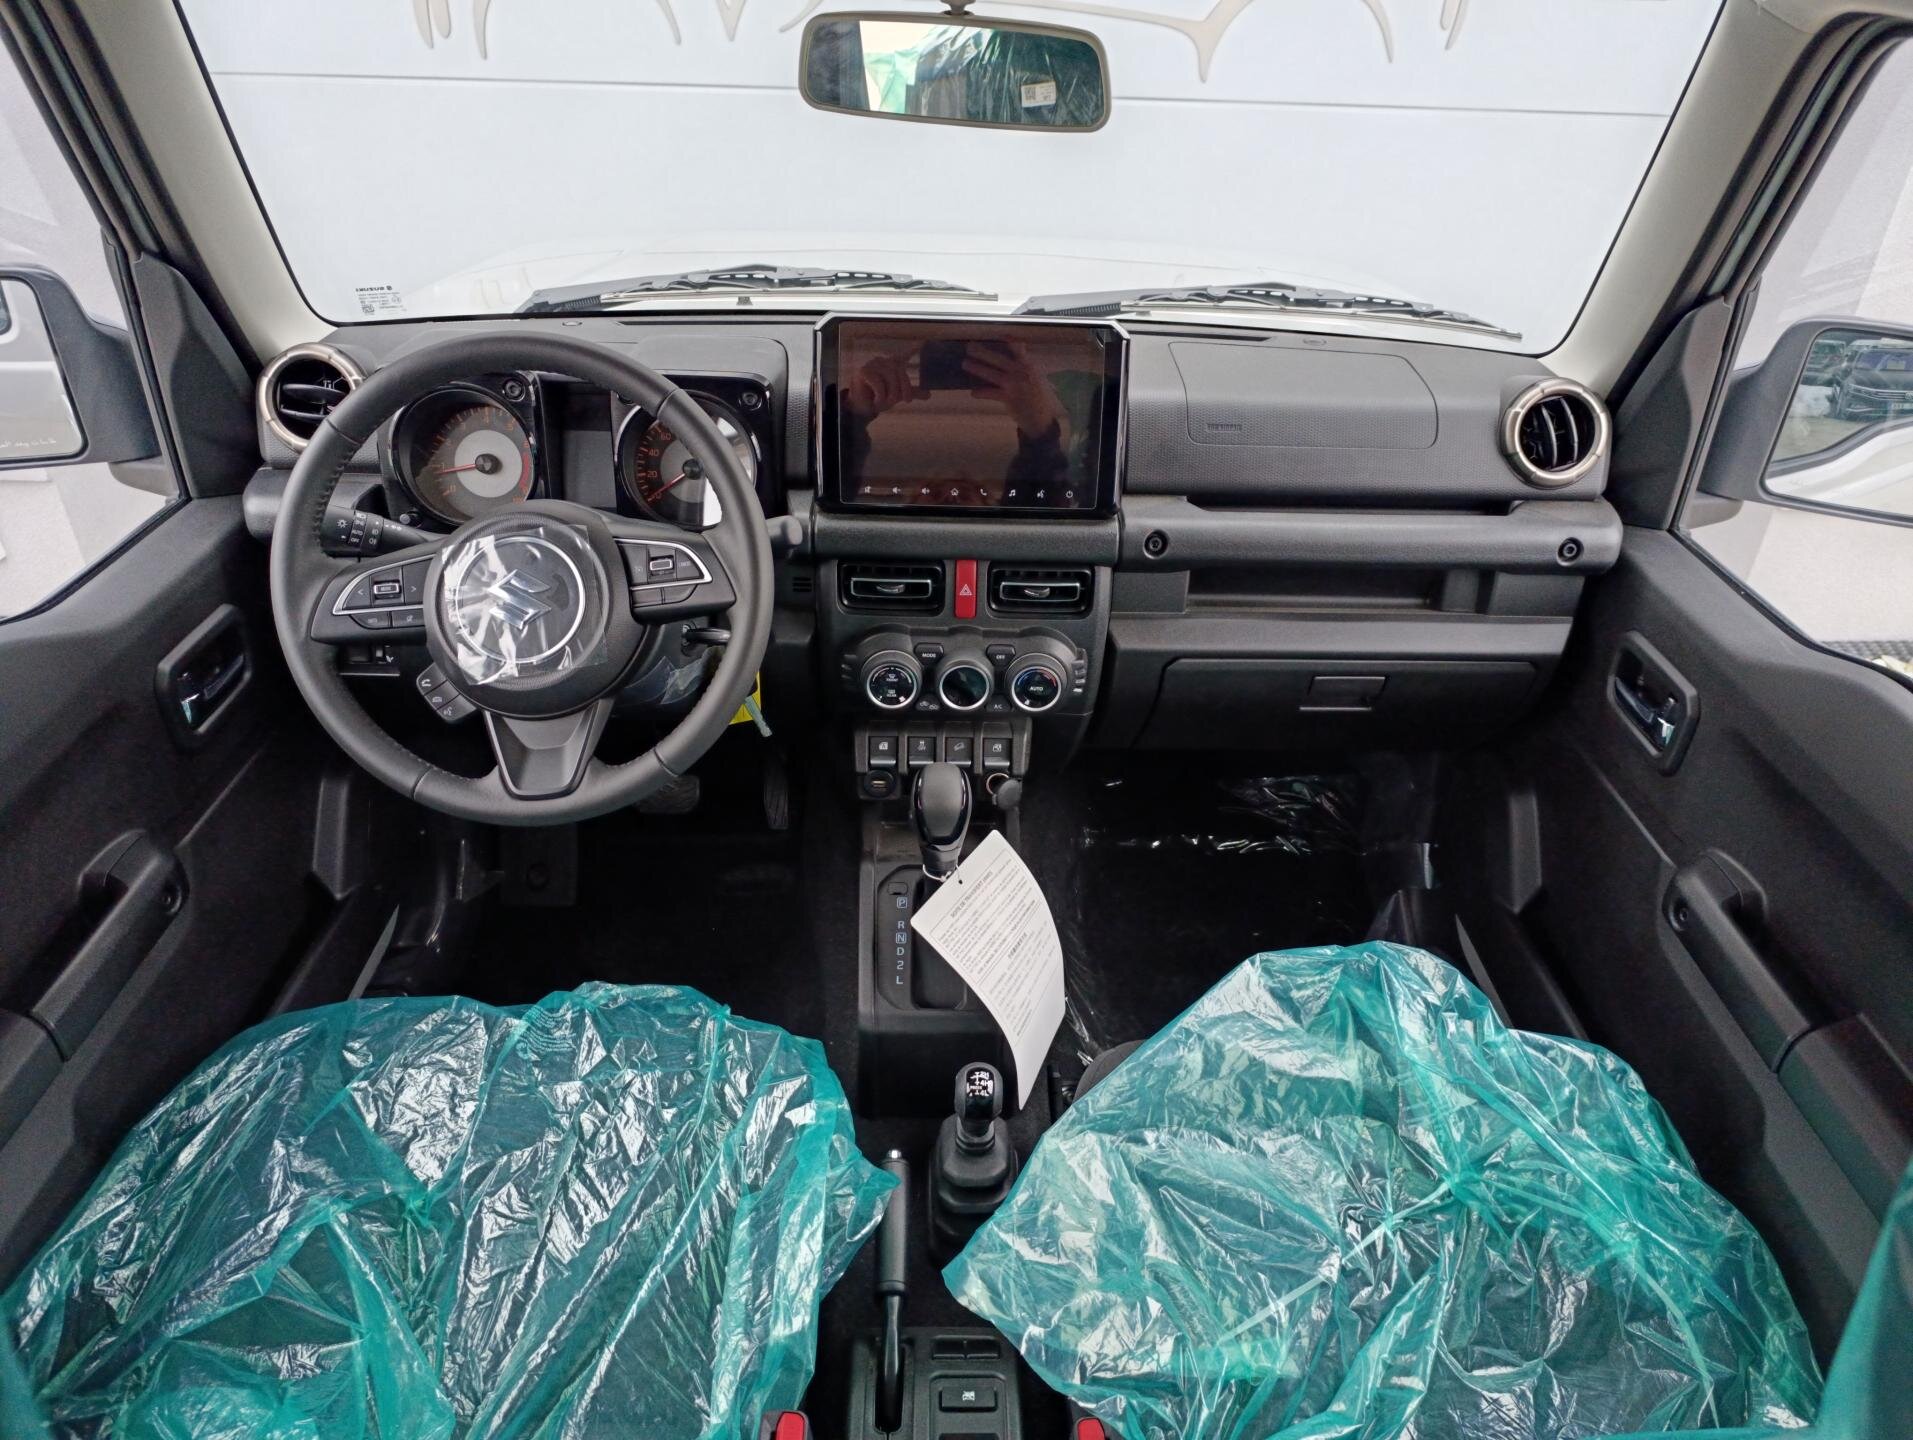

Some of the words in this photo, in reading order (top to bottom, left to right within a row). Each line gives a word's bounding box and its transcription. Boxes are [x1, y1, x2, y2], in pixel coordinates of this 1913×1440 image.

[649, 449, 660, 457] 40
[647, 470, 657, 478] 20
[897, 920, 905, 929] R
[896, 947, 905, 956] D
[896, 960, 904, 970] 2
[896, 975, 904, 985] L
